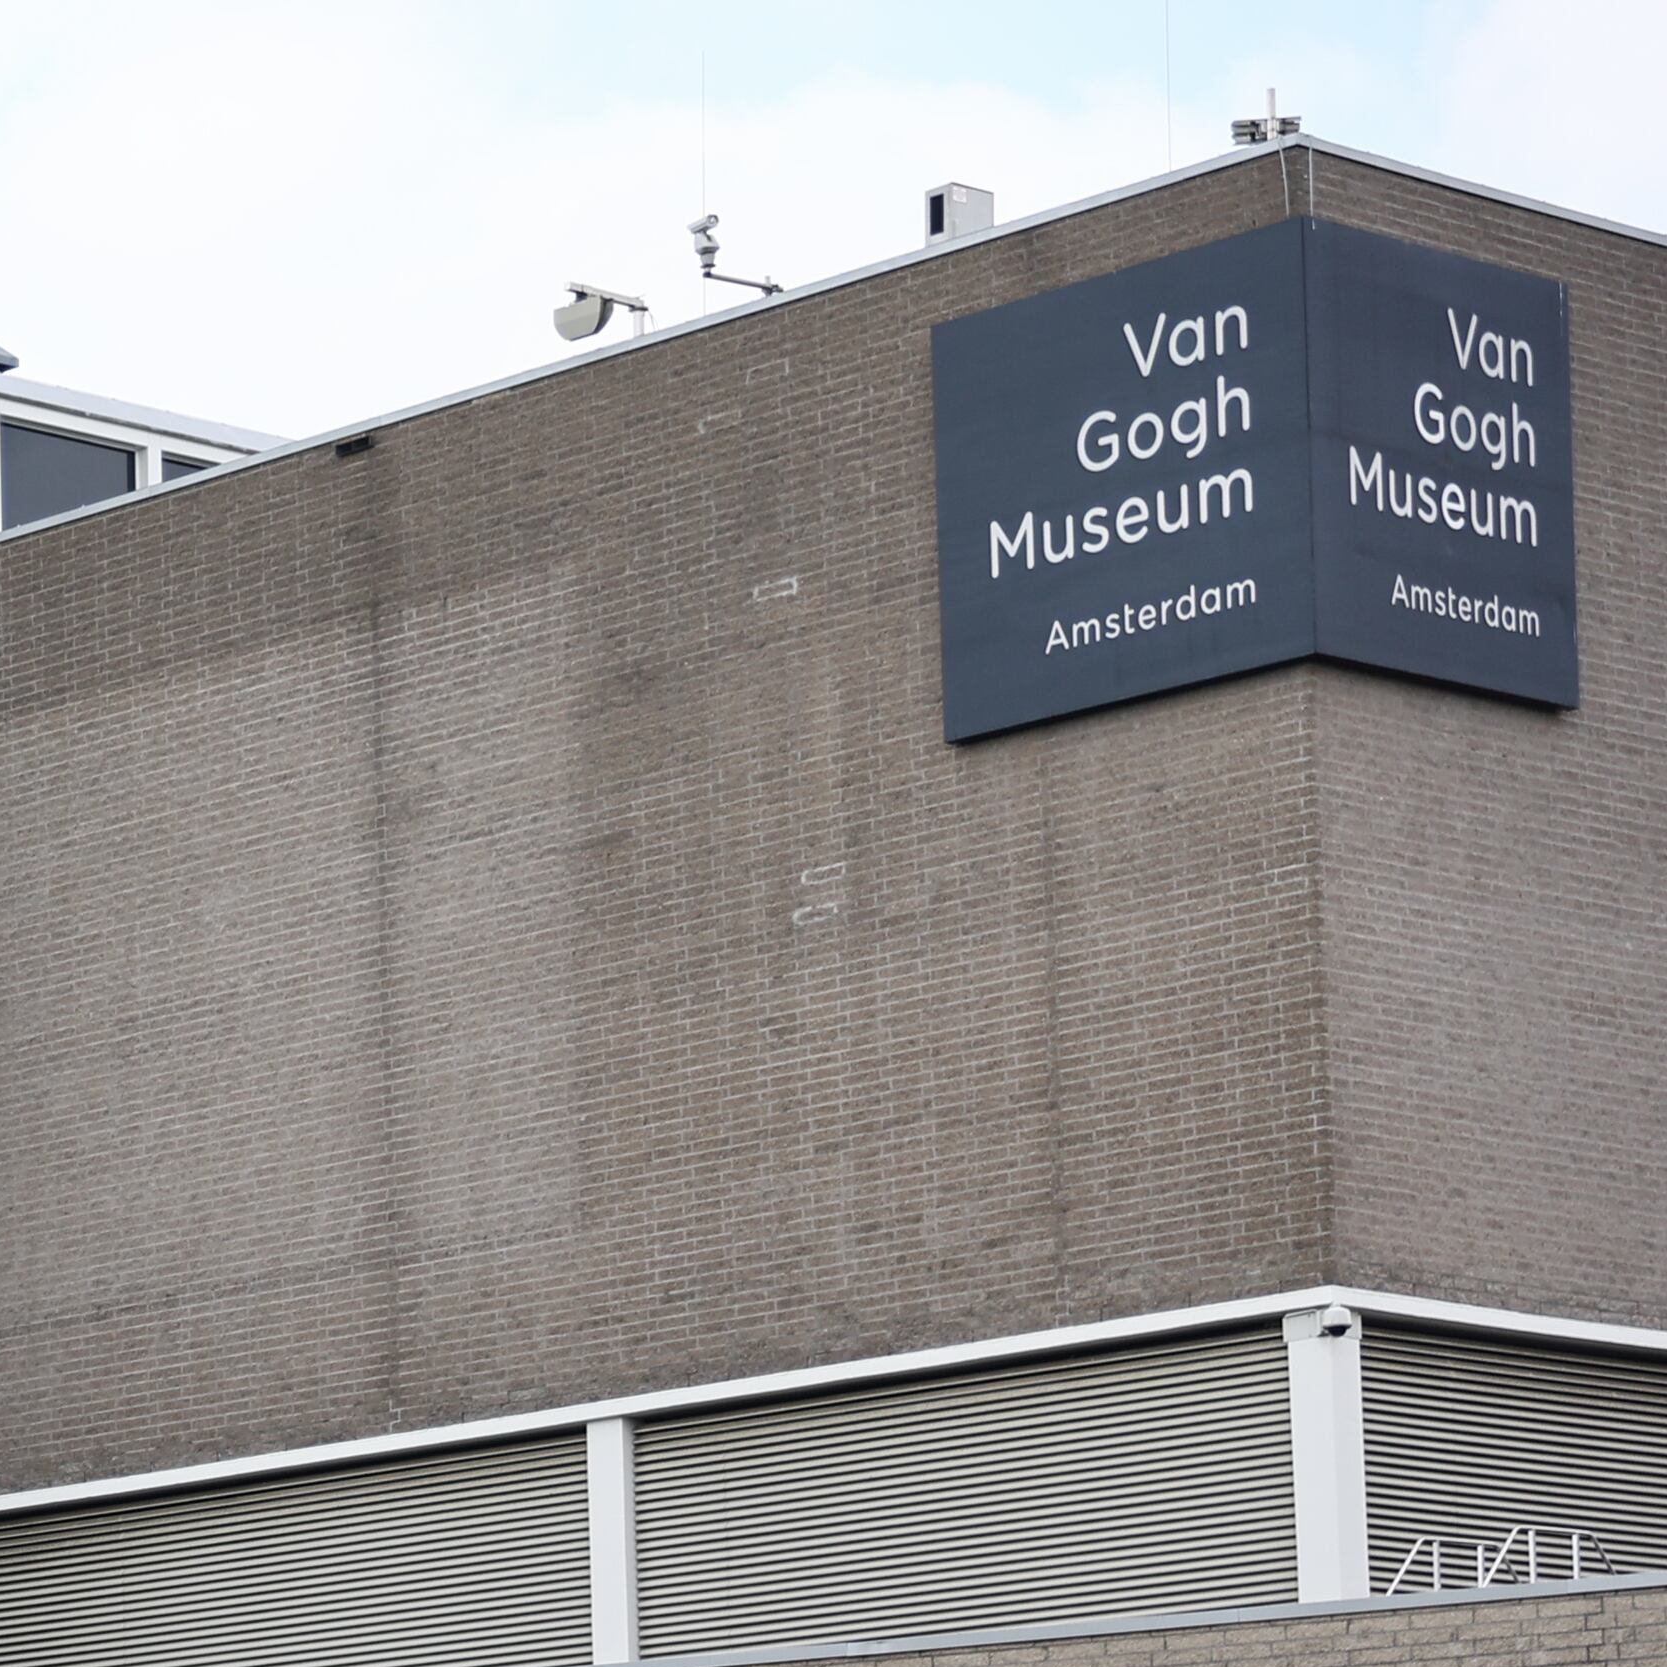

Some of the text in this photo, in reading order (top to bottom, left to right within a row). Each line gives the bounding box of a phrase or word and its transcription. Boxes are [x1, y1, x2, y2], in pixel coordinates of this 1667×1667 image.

[1123, 305, 1249, 377] Van
[1447, 307, 1534, 387] Van
[1077, 375, 1251, 473] Gogh
[1413, 382, 1537, 471] Gogh
[989, 467, 1255, 579] Museum
[1348, 445, 1538, 547] Museum
[1045, 577, 1257, 655] Amsterdam
[1391, 574, 1541, 638] Amsterdam
